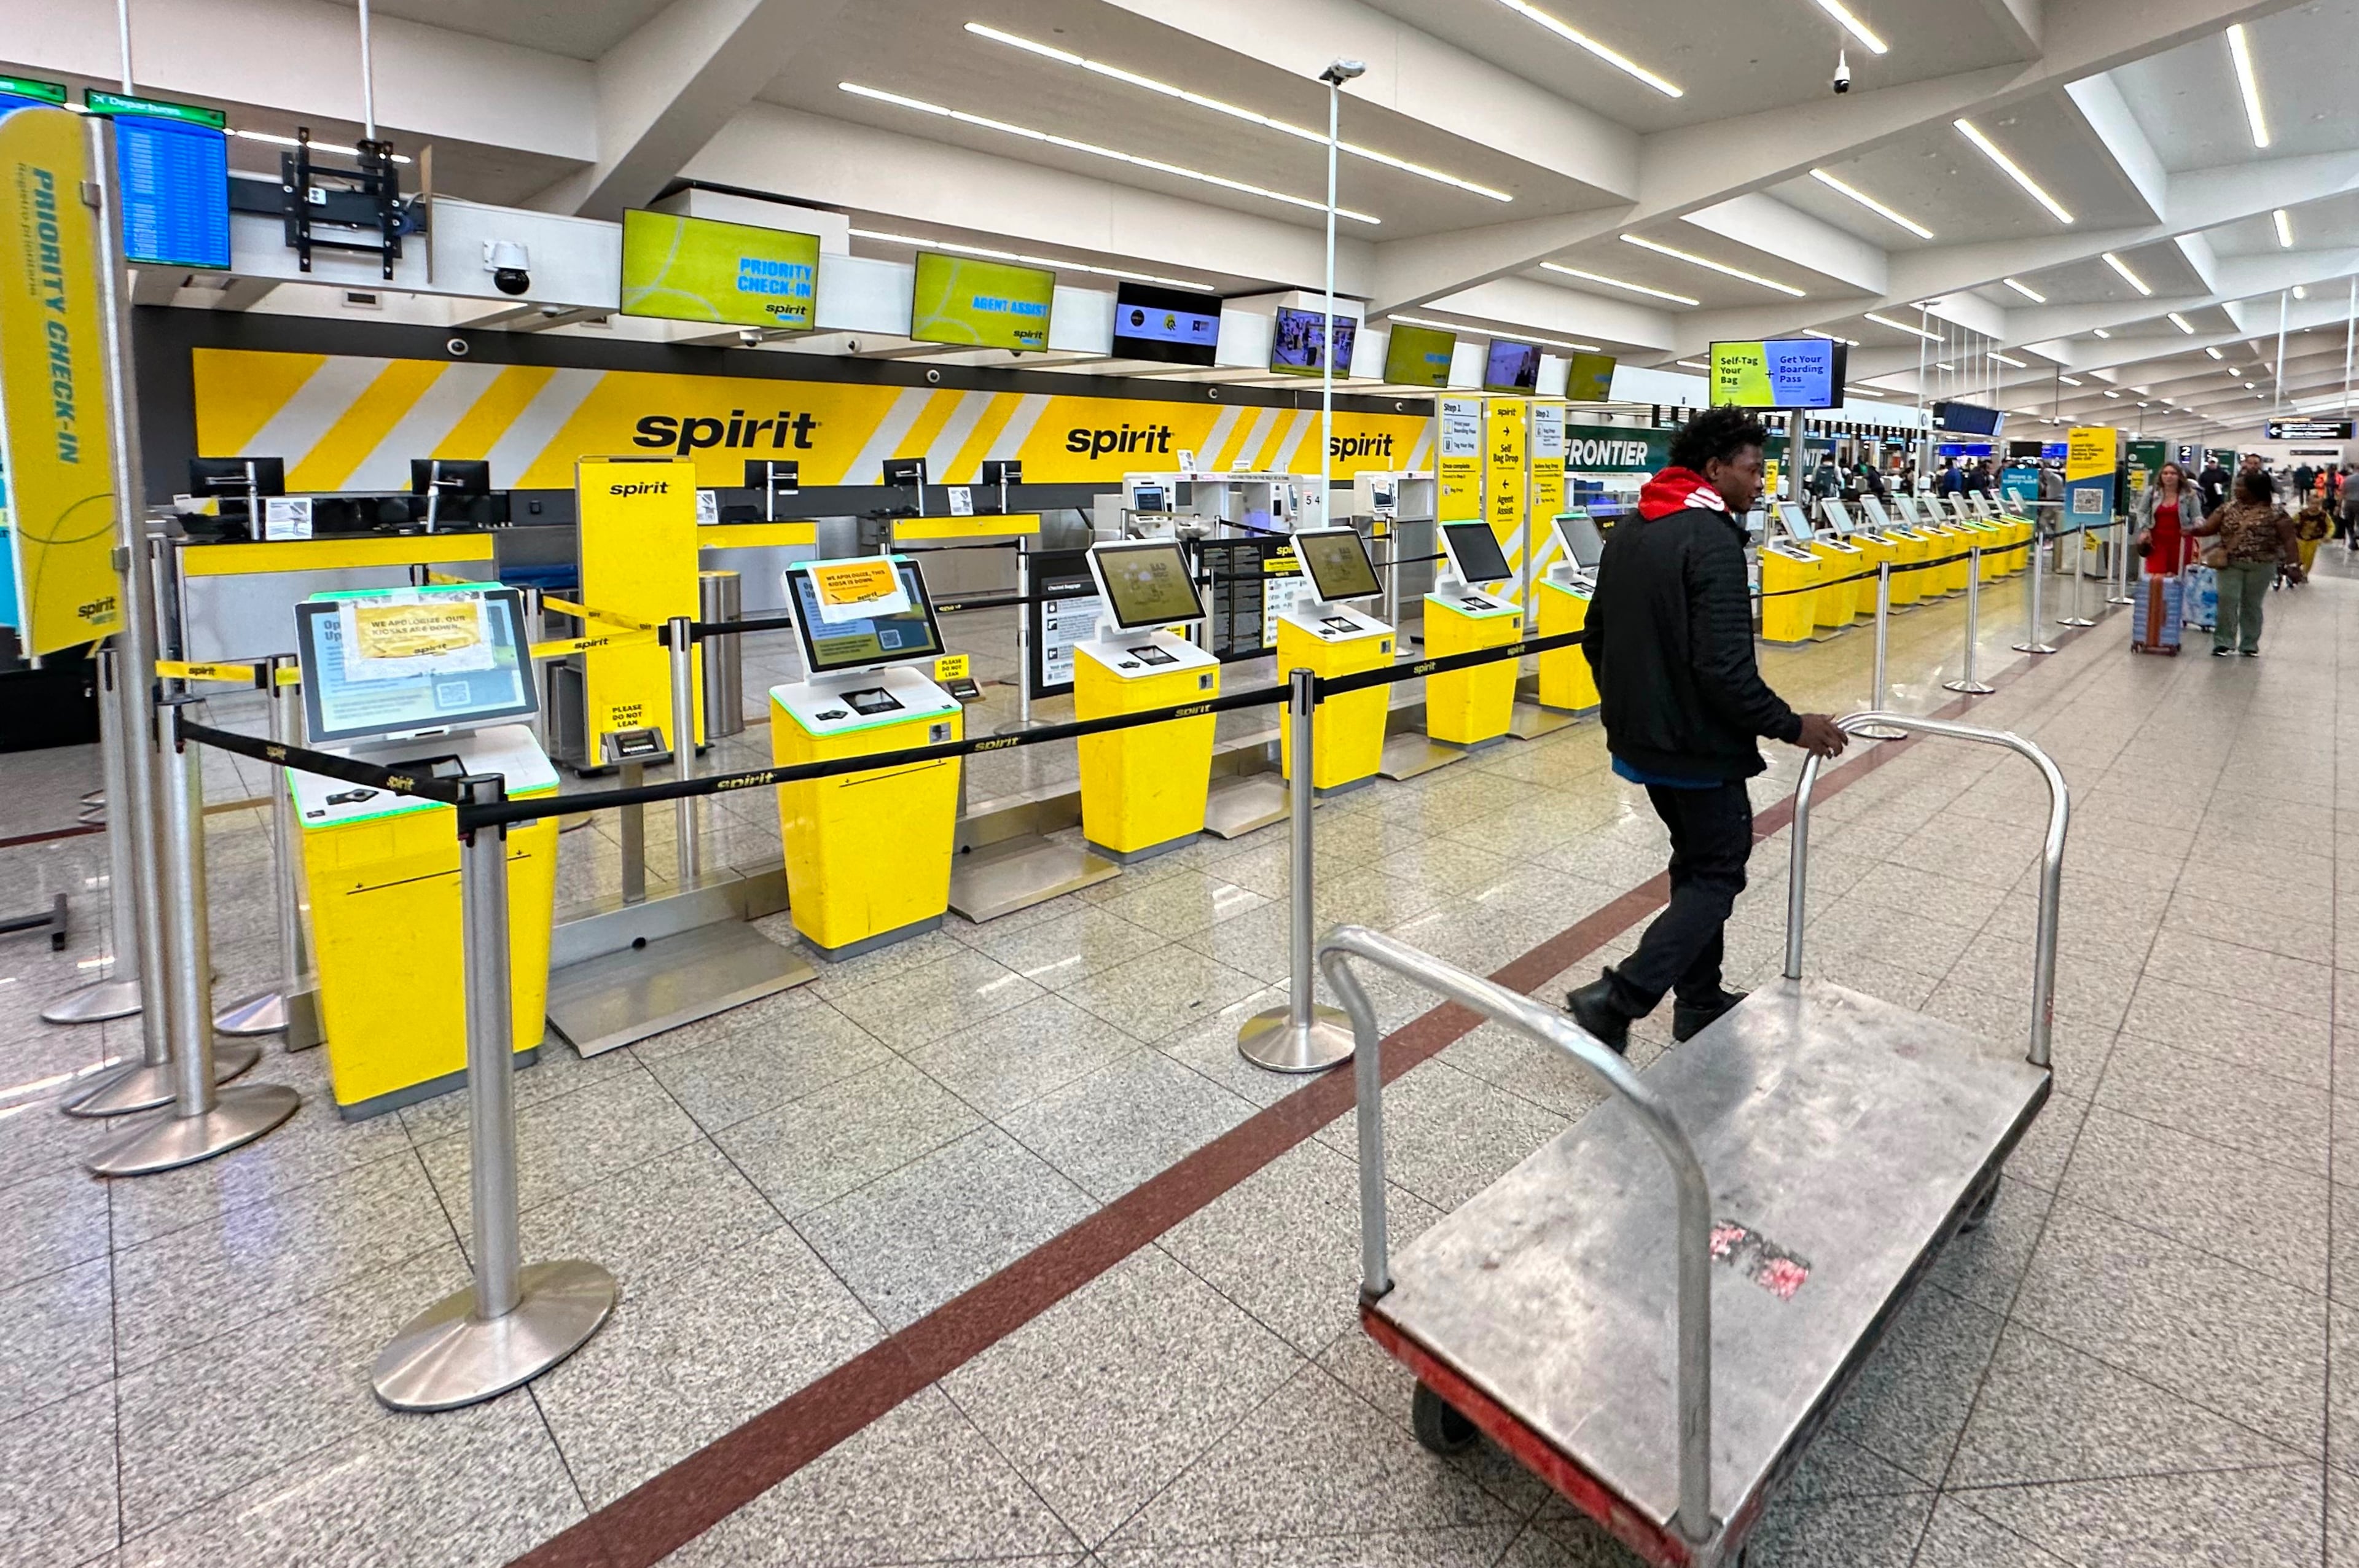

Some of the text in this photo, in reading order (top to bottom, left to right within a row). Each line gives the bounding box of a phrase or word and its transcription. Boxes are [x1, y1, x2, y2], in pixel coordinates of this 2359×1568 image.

[740, 257, 813, 281] PRIORITY
[738, 275, 811, 298] CHECK-IN
[765, 304, 807, 315] spirit
[972, 295, 1048, 318] AGENT ASSIST
[33, 167, 79, 464] PRIORITY CHECK-IN
[1014, 330, 1043, 339] spirit
[1721, 356, 1758, 365] Self-Tag
[1799, 355, 1822, 364] Your
[1780, 365, 1824, 375] Boarding
[1721, 376, 1738, 385] Bag
[1497, 408, 1517, 417] spirit
[633, 409, 817, 456] spirit
[1065, 424, 1172, 459] spirit
[1330, 432, 1393, 462] spirit
[1500, 444, 1512, 453] Self
[1564, 439, 1648, 466] FRONTIER
[2181, 446, 2191, 456] 2
[1493, 454, 1519, 464] Bag Drop
[609, 482, 669, 497] spirit
[1497, 495, 1514, 505] Agent
[1496, 506, 1514, 515] Assist
[77, 596, 116, 619] spirit
[574, 638, 610, 649] spirit
[1507, 644, 1525, 656] spirit
[188, 666, 216, 676] spirit
[1414, 661, 1436, 674] spirit
[612, 704, 643, 713] PLEASE
[1175, 704, 1212, 717] spirit
[974, 737, 1019, 751] spirit
[717, 771, 775, 789] spirit
